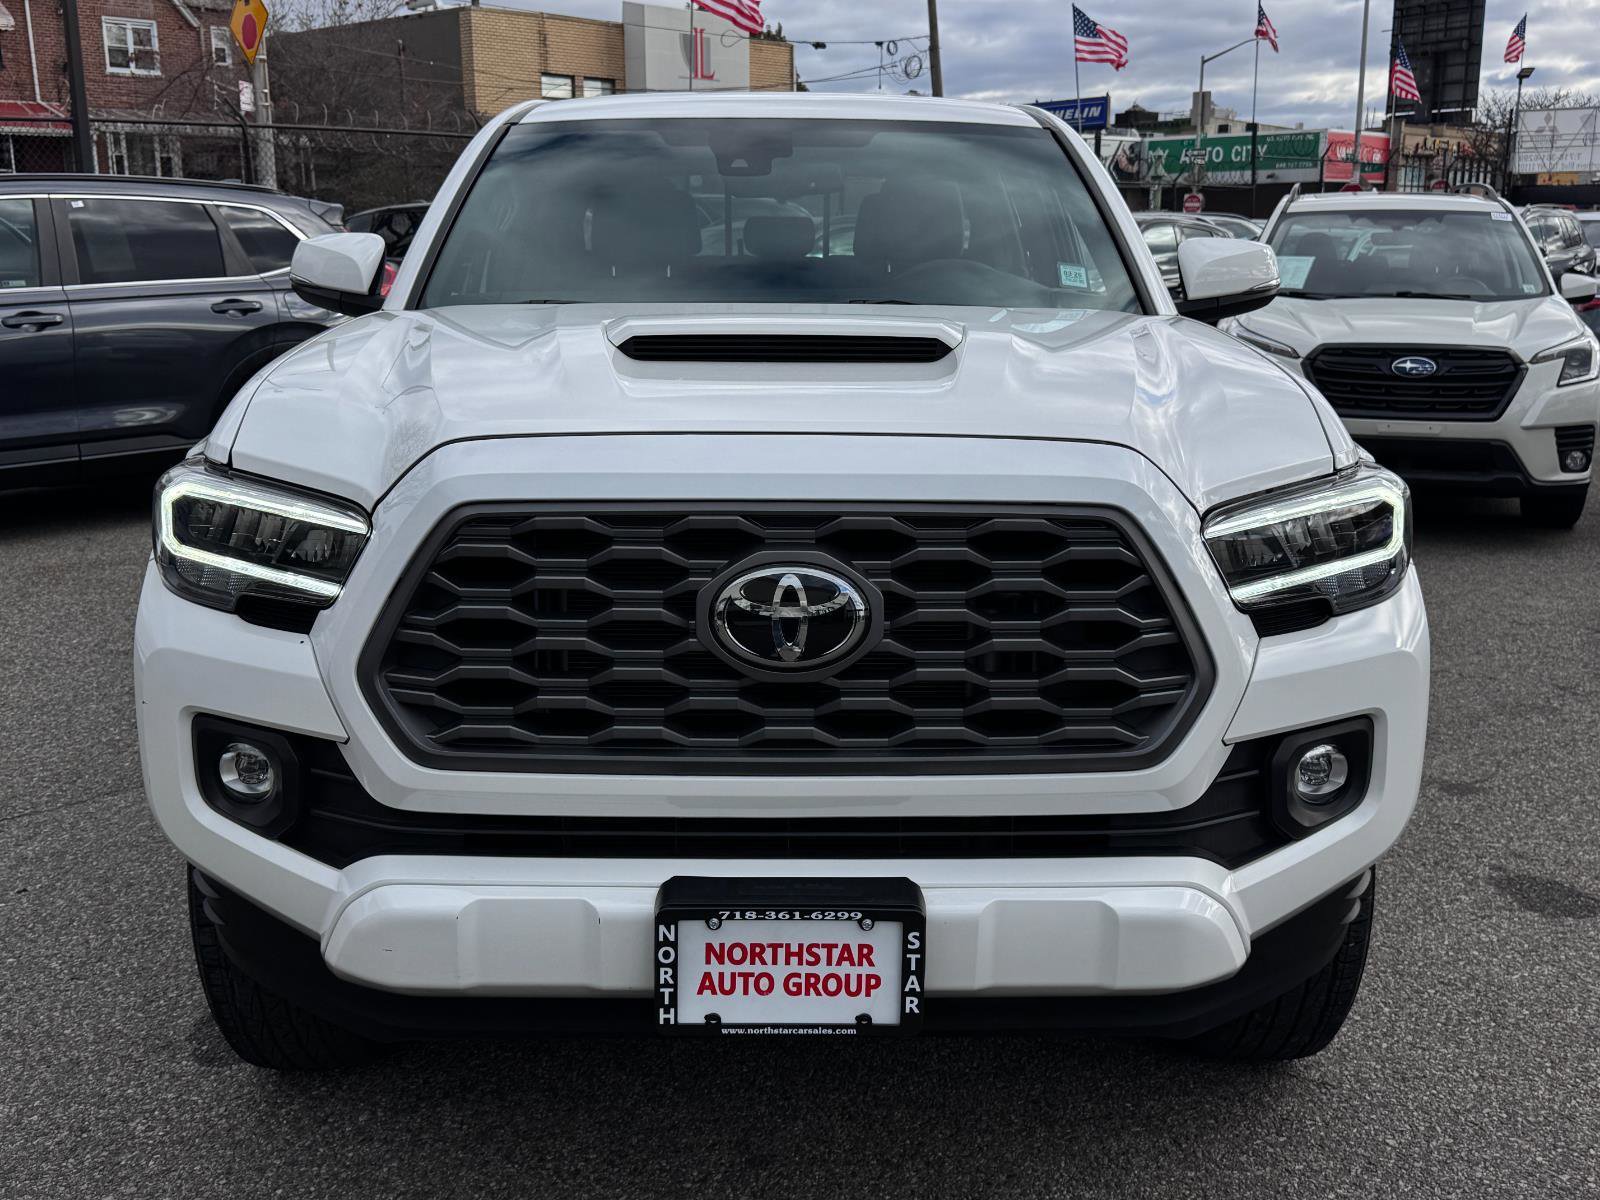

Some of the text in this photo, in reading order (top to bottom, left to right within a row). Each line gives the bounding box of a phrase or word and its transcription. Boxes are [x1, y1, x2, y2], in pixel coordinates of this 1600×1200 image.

[1179, 146, 1223, 165] ATO
[1231, 144, 1268, 162] CITY
[718, 911, 863, 921] 718-361-6299
[704, 942, 875, 967] NORTHSTAR
[657, 924, 676, 1025] NORTH
[697, 972, 882, 998] AUTO GROUP
[904, 931, 921, 1014] STAR
[721, 1026, 857, 1036] www.northstarcarsales.com
